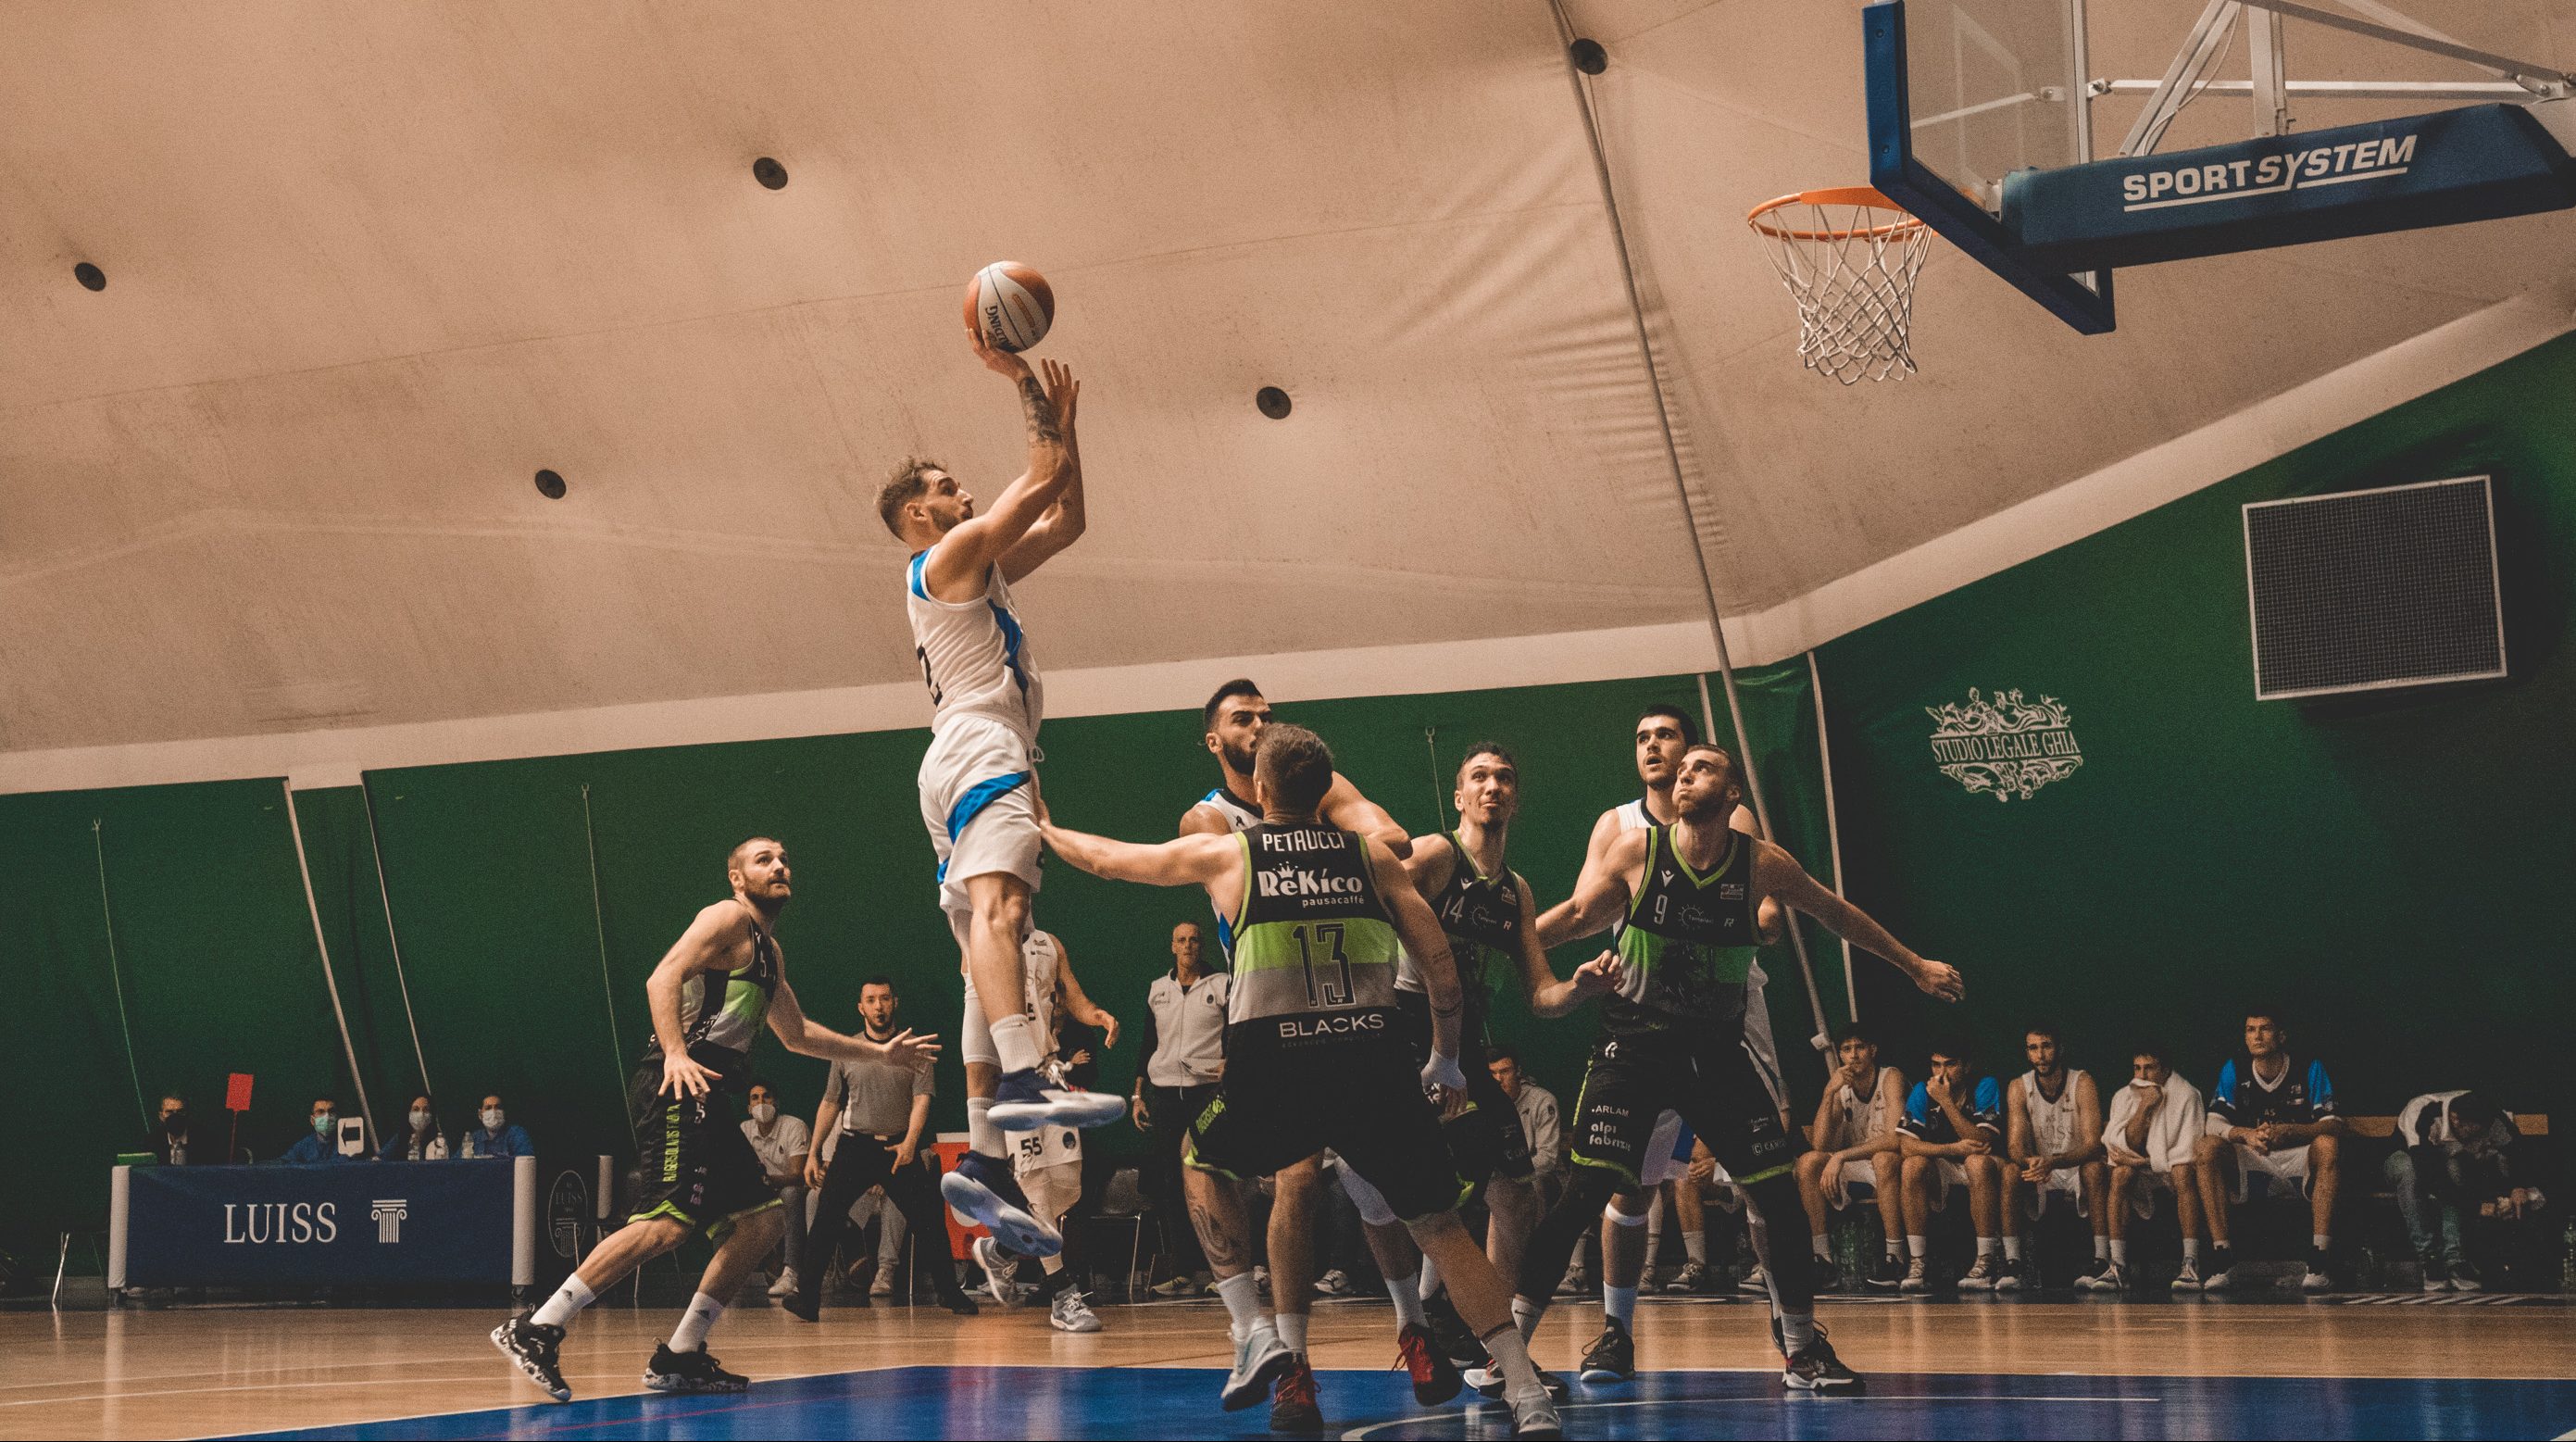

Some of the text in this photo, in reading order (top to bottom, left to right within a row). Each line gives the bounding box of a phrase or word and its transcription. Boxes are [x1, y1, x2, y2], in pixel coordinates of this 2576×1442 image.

[2123, 134, 2418, 201] SPORT SYSTEM
[1932, 730, 2082, 763] STUDIO LEGALE GHIA
[1262, 829, 1345, 852] PETRUCCI
[1441, 895, 1466, 924] 14
[1654, 894, 1669, 925] 9
[1293, 922, 1357, 1008] 13
[1279, 1013, 1384, 1038] BLACKS
[1020, 1136, 1043, 1158] 55
[223, 1202, 337, 1244] LUISS
